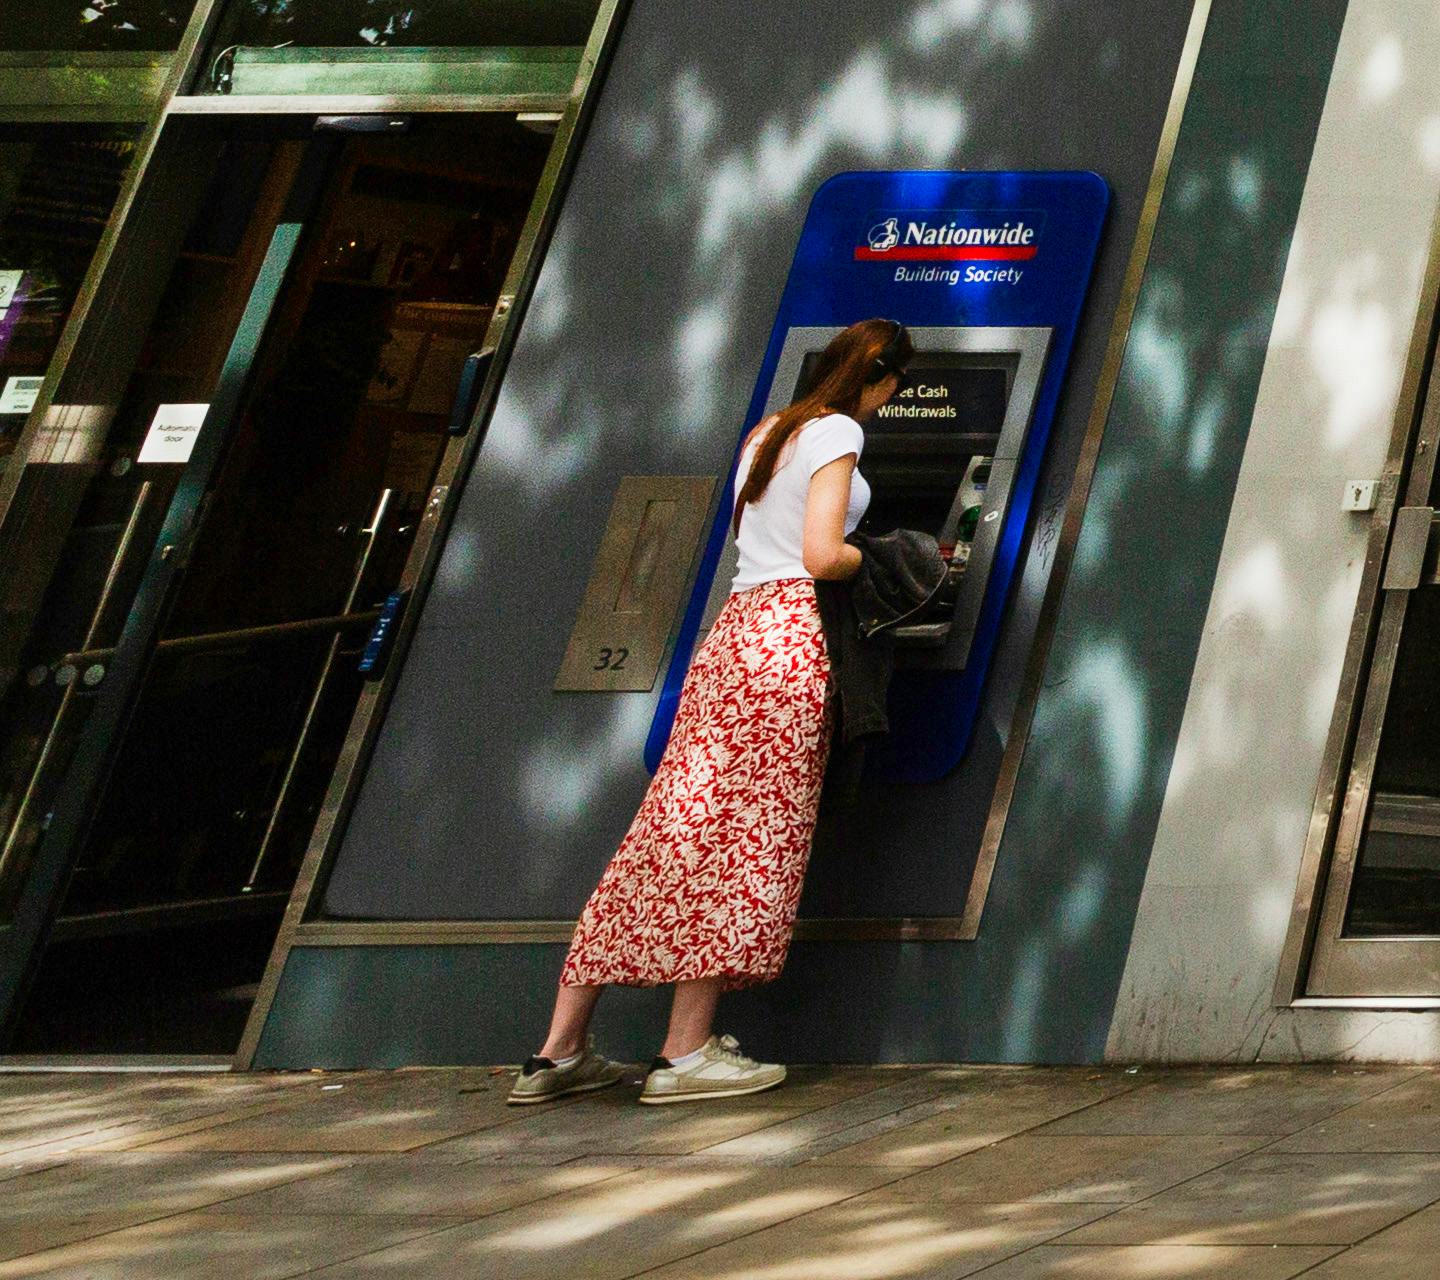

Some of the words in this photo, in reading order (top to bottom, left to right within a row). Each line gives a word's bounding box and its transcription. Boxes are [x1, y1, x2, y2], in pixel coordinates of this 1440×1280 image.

[903, 221, 1034, 245] Nationwide
[894, 266, 961, 286] Building
[964, 265, 1023, 286] Society
[917, 385, 948, 398] Cash
[877, 405, 957, 419] Withdrawals
[157, 424, 199, 433] Automatic
[163, 435, 184, 443] door
[593, 647, 629, 671] 32
